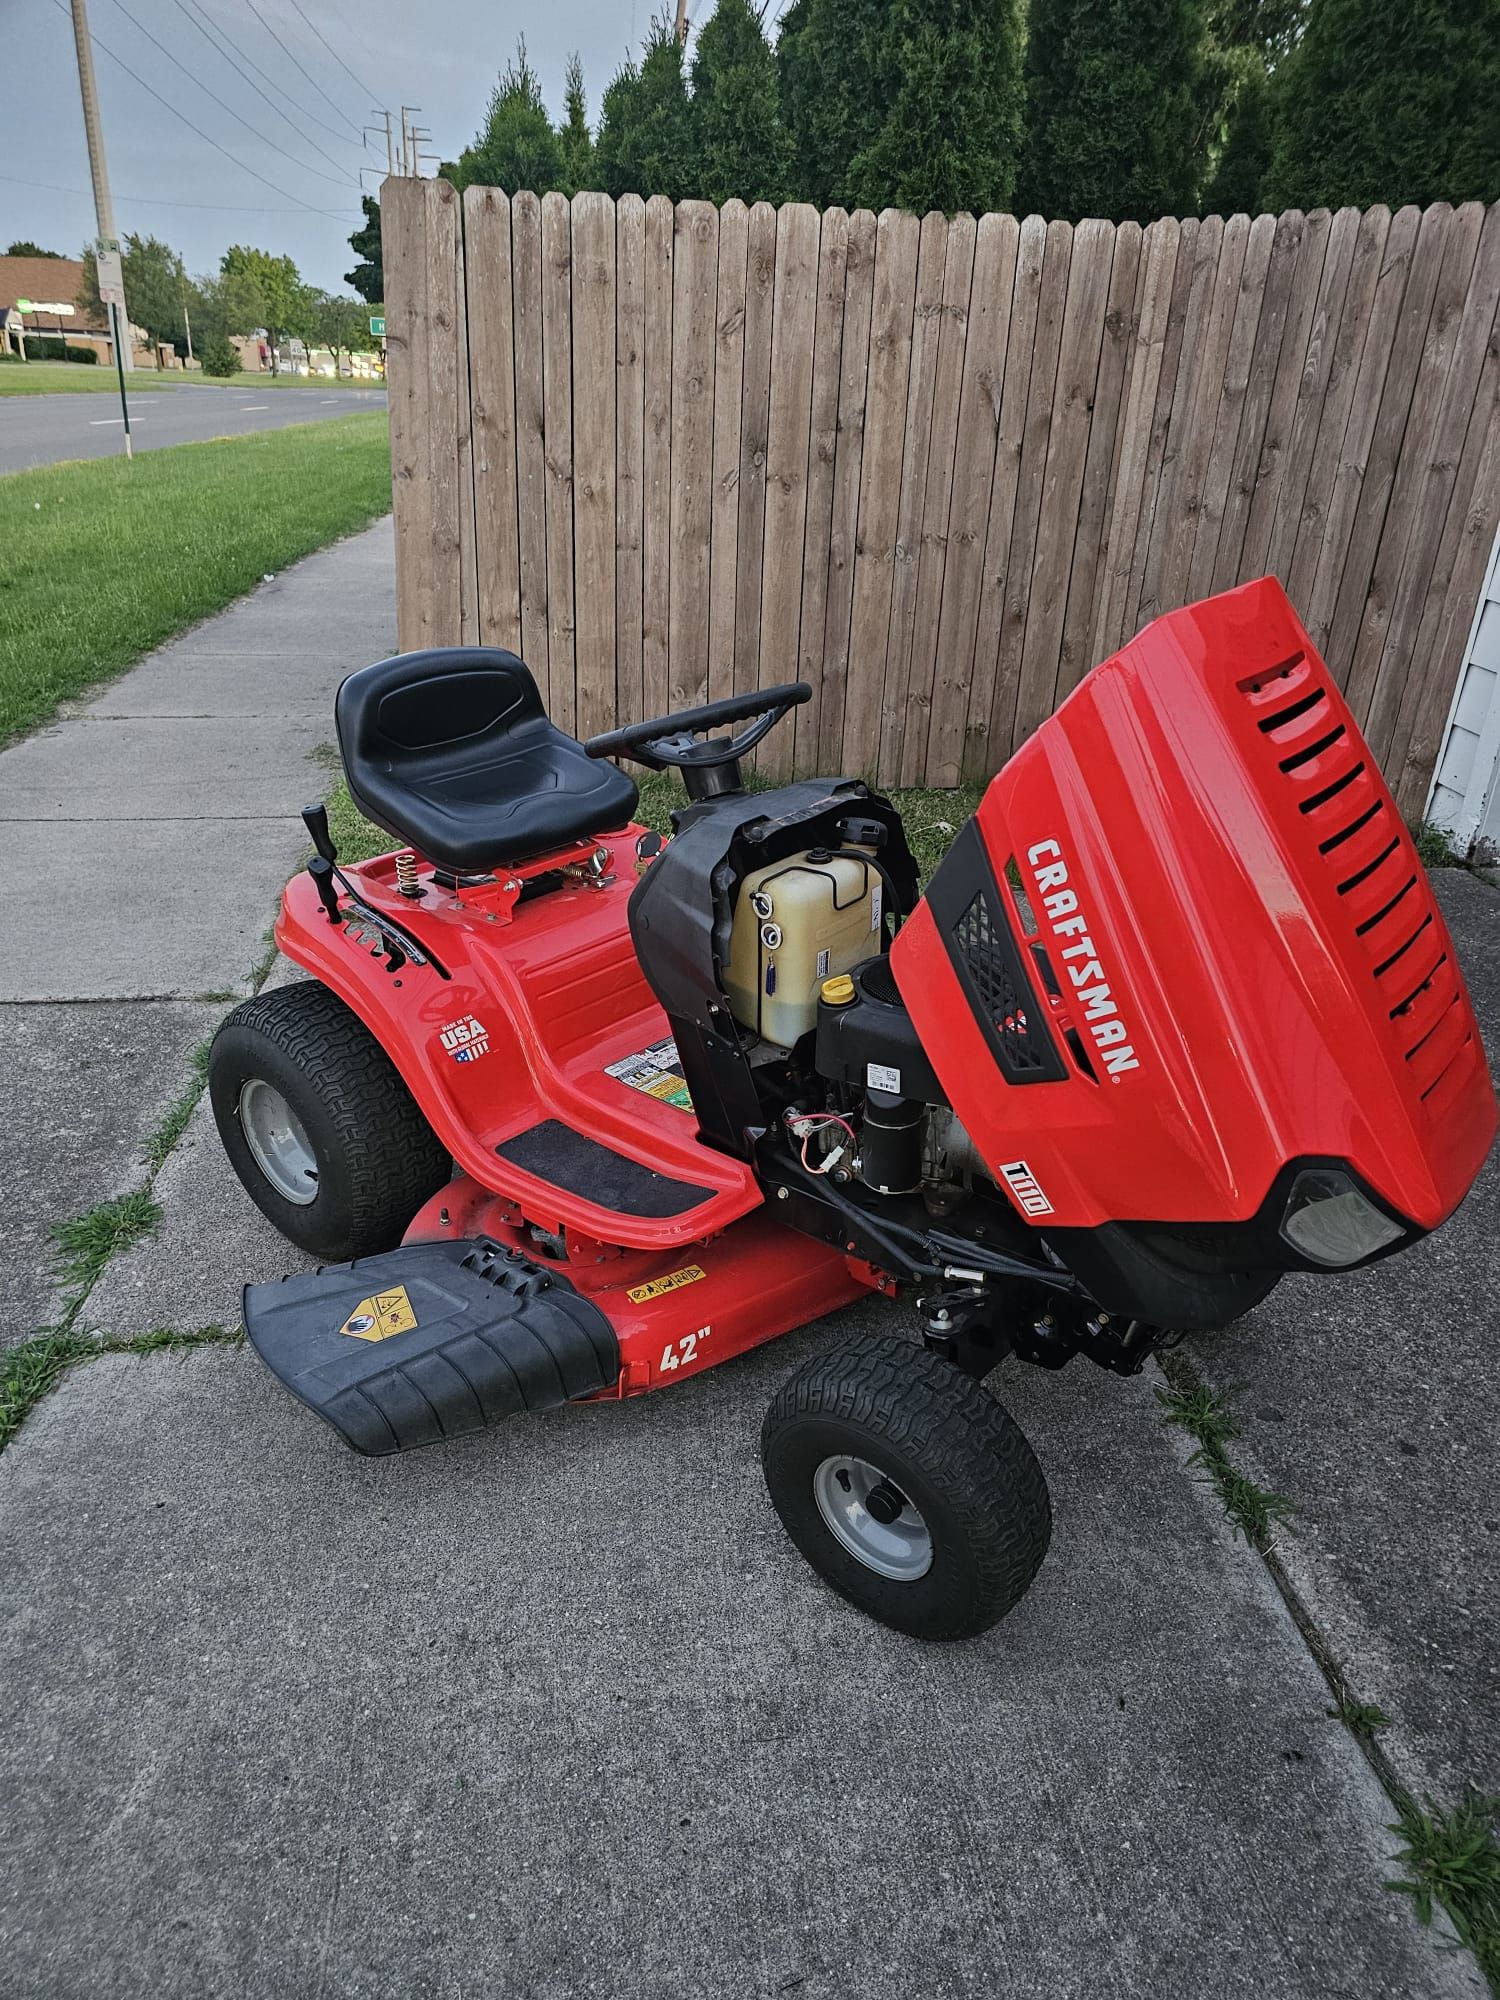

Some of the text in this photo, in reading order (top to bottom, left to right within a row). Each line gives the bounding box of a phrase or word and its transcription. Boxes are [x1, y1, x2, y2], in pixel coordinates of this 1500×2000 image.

[1027, 838, 1140, 1075] CRAFTSMAN
[439, 1019, 487, 1050] USA
[441, 1022, 457, 1032] MADE
[463, 1014, 473, 1022] THE
[1005, 1163, 1050, 1212] T110
[660, 1325, 711, 1372] 42"
